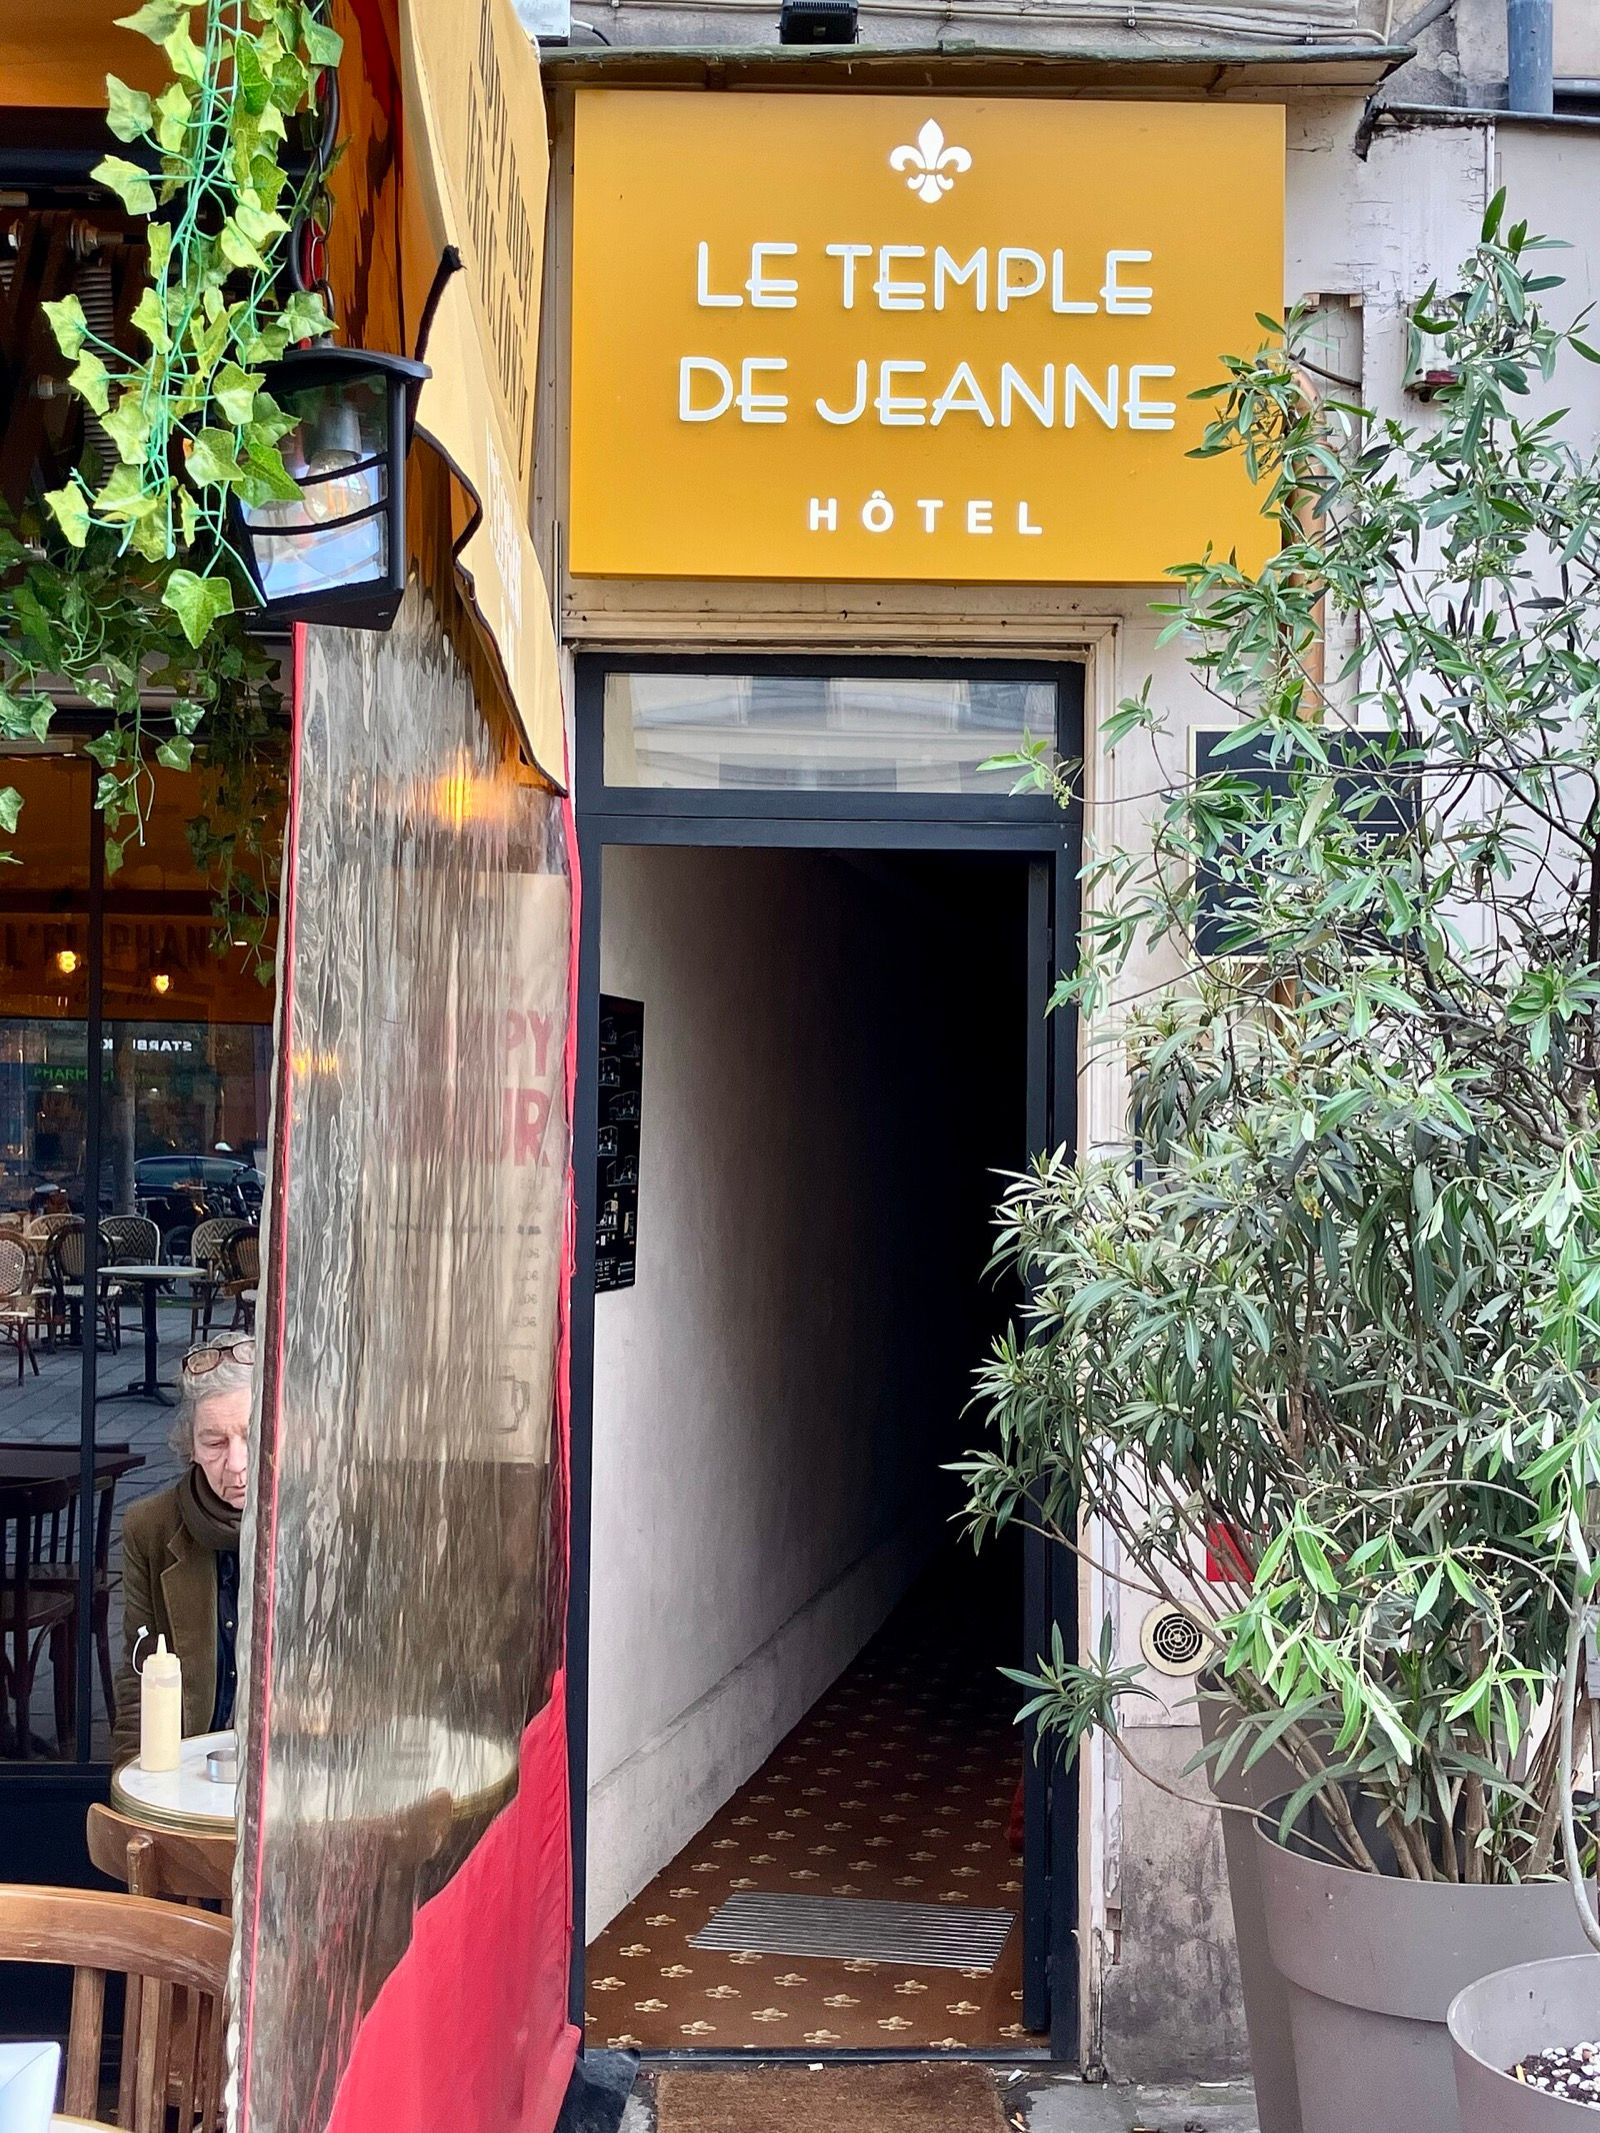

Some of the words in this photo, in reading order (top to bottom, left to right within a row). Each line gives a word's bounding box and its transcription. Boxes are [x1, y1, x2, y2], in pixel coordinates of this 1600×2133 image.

[697, 241, 798, 308] LE
[825, 244, 1153, 315] TEMPLE
[678, 356, 789, 424] DE
[815, 359, 1176, 430] JEANNE
[808, 490, 1043, 535] HÔTEL
